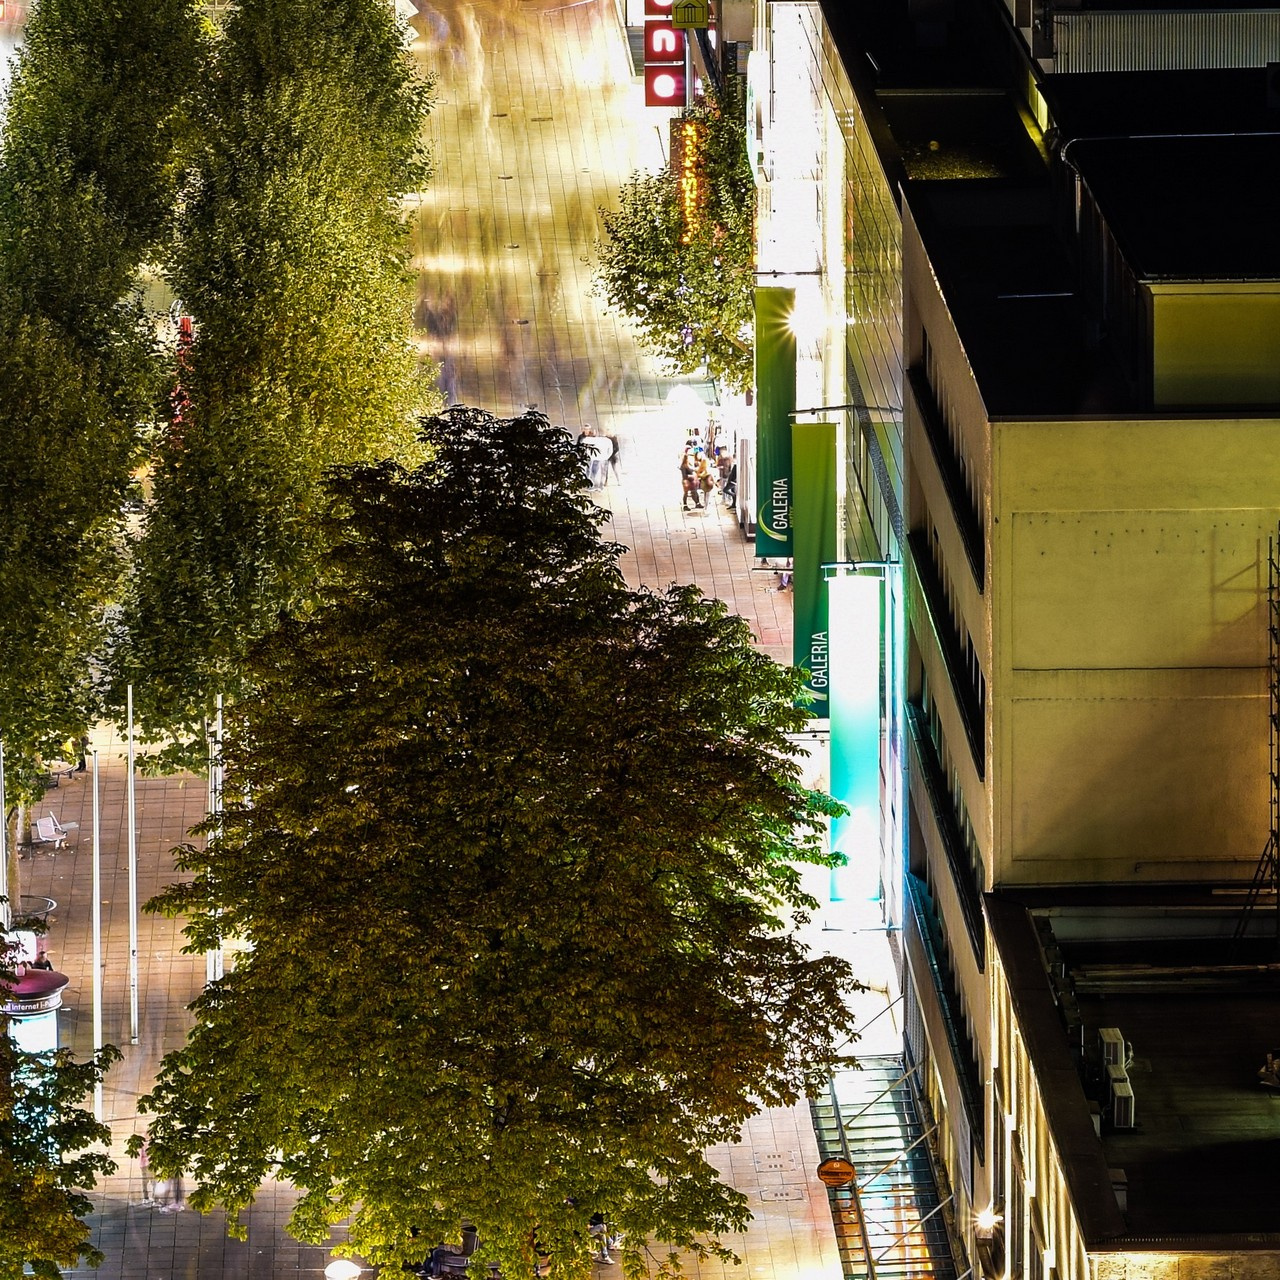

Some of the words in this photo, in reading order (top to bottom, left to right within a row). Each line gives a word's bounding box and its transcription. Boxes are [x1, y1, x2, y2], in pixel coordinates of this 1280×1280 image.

[772, 477, 788, 530] GALERIA
[811, 631, 828, 688] GALERIA
[12, 1002, 39, 1011] Internet
